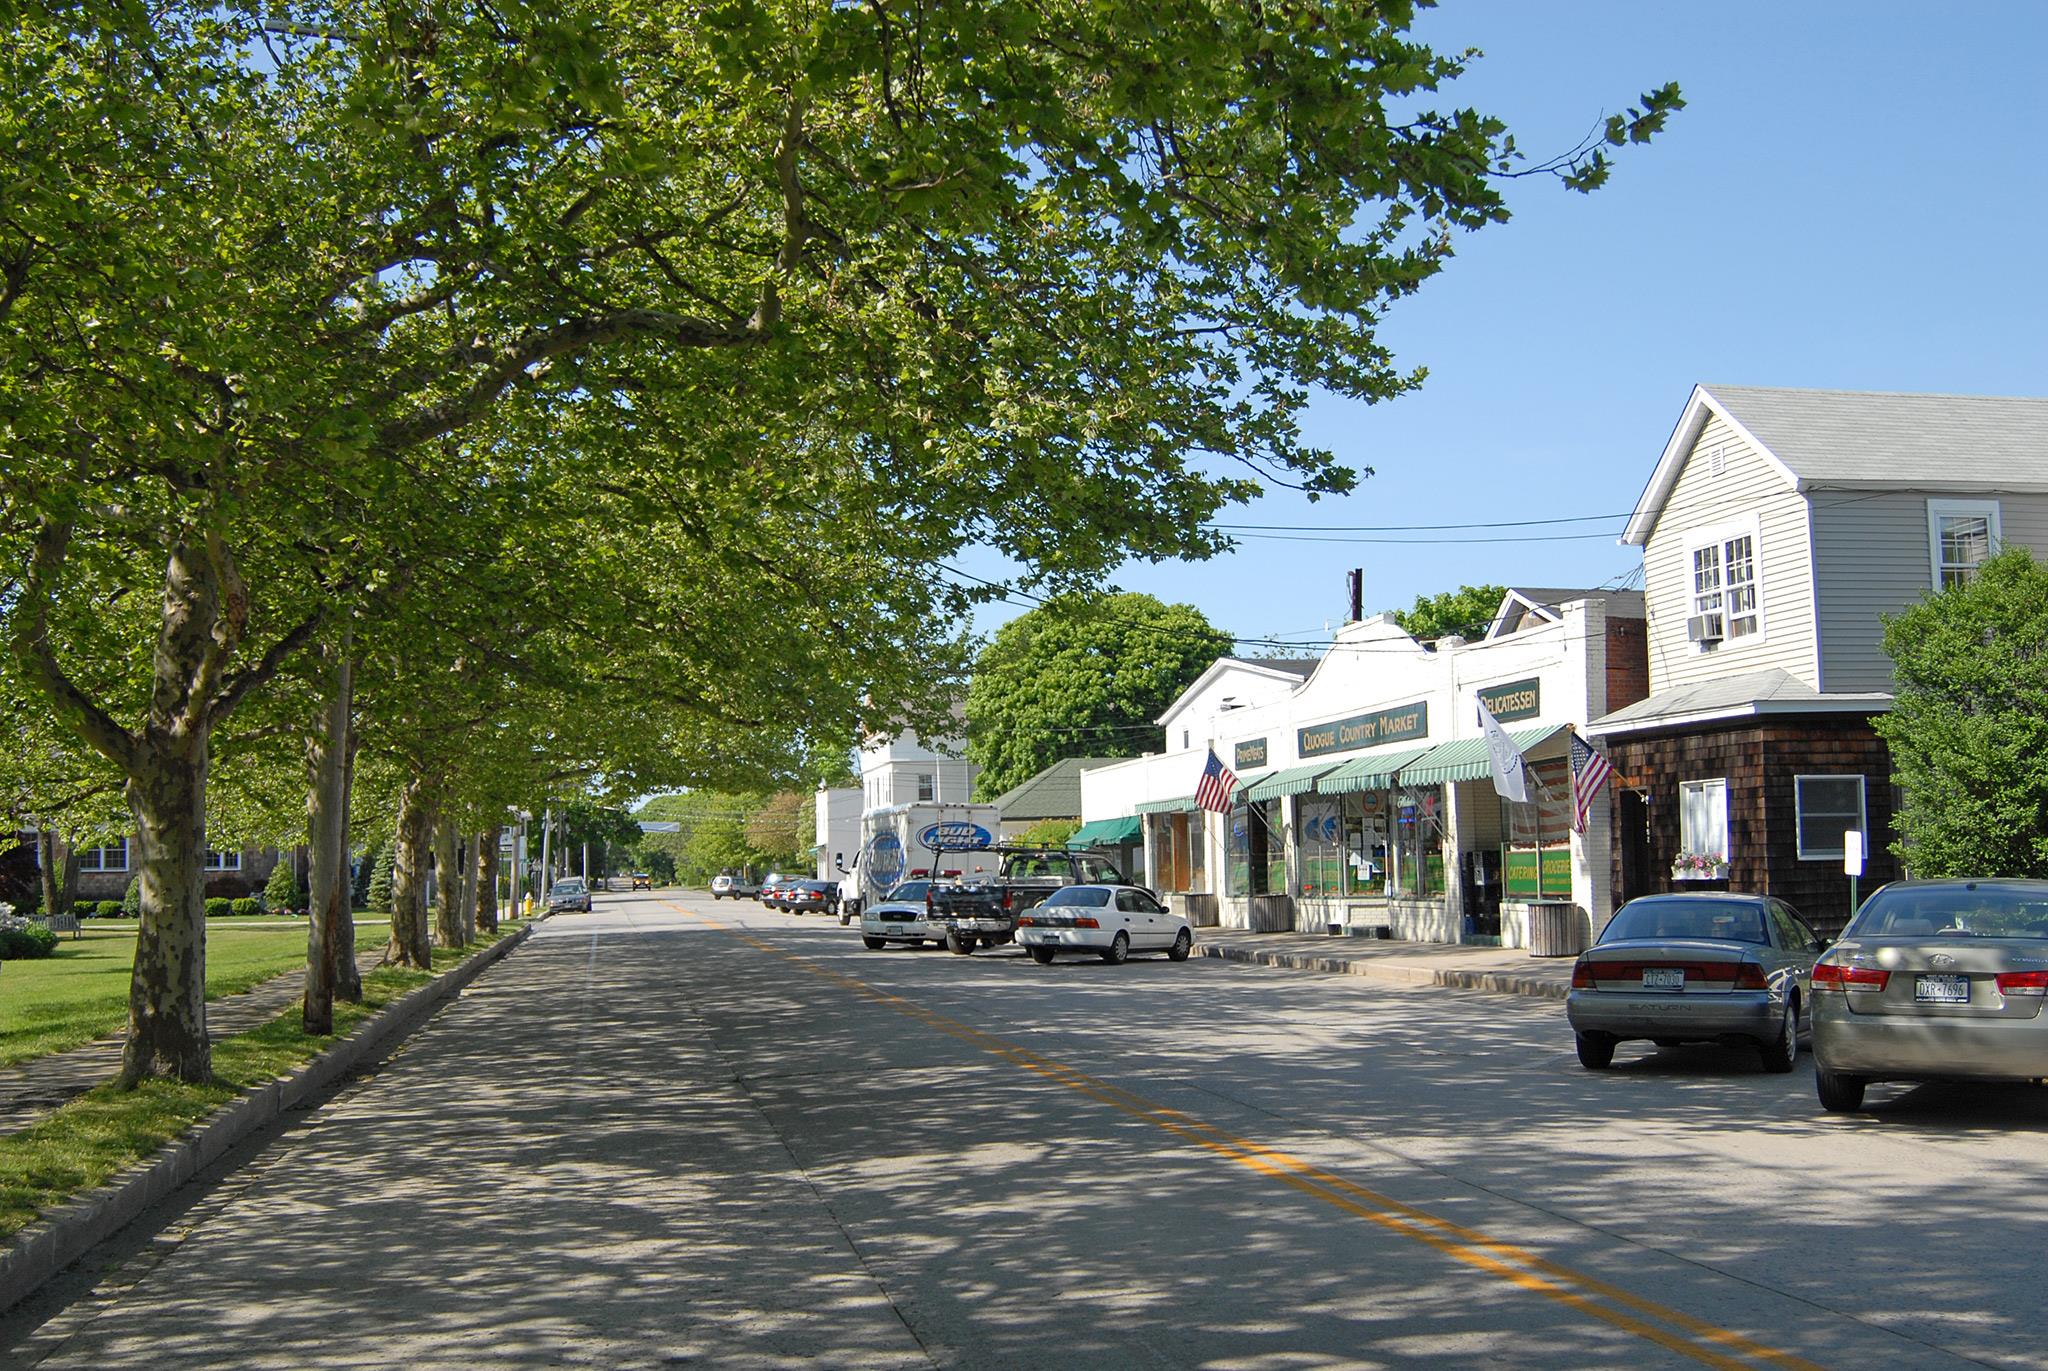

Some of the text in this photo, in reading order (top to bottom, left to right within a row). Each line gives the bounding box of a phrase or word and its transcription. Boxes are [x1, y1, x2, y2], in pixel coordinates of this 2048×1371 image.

[1480, 690, 1536, 714] DELICATESSEN
[1303, 713, 1418, 751] QUOGUE COUNTRY MARKET
[935, 825, 976, 836] BUD
[927, 836, 983, 846] LIGHT
